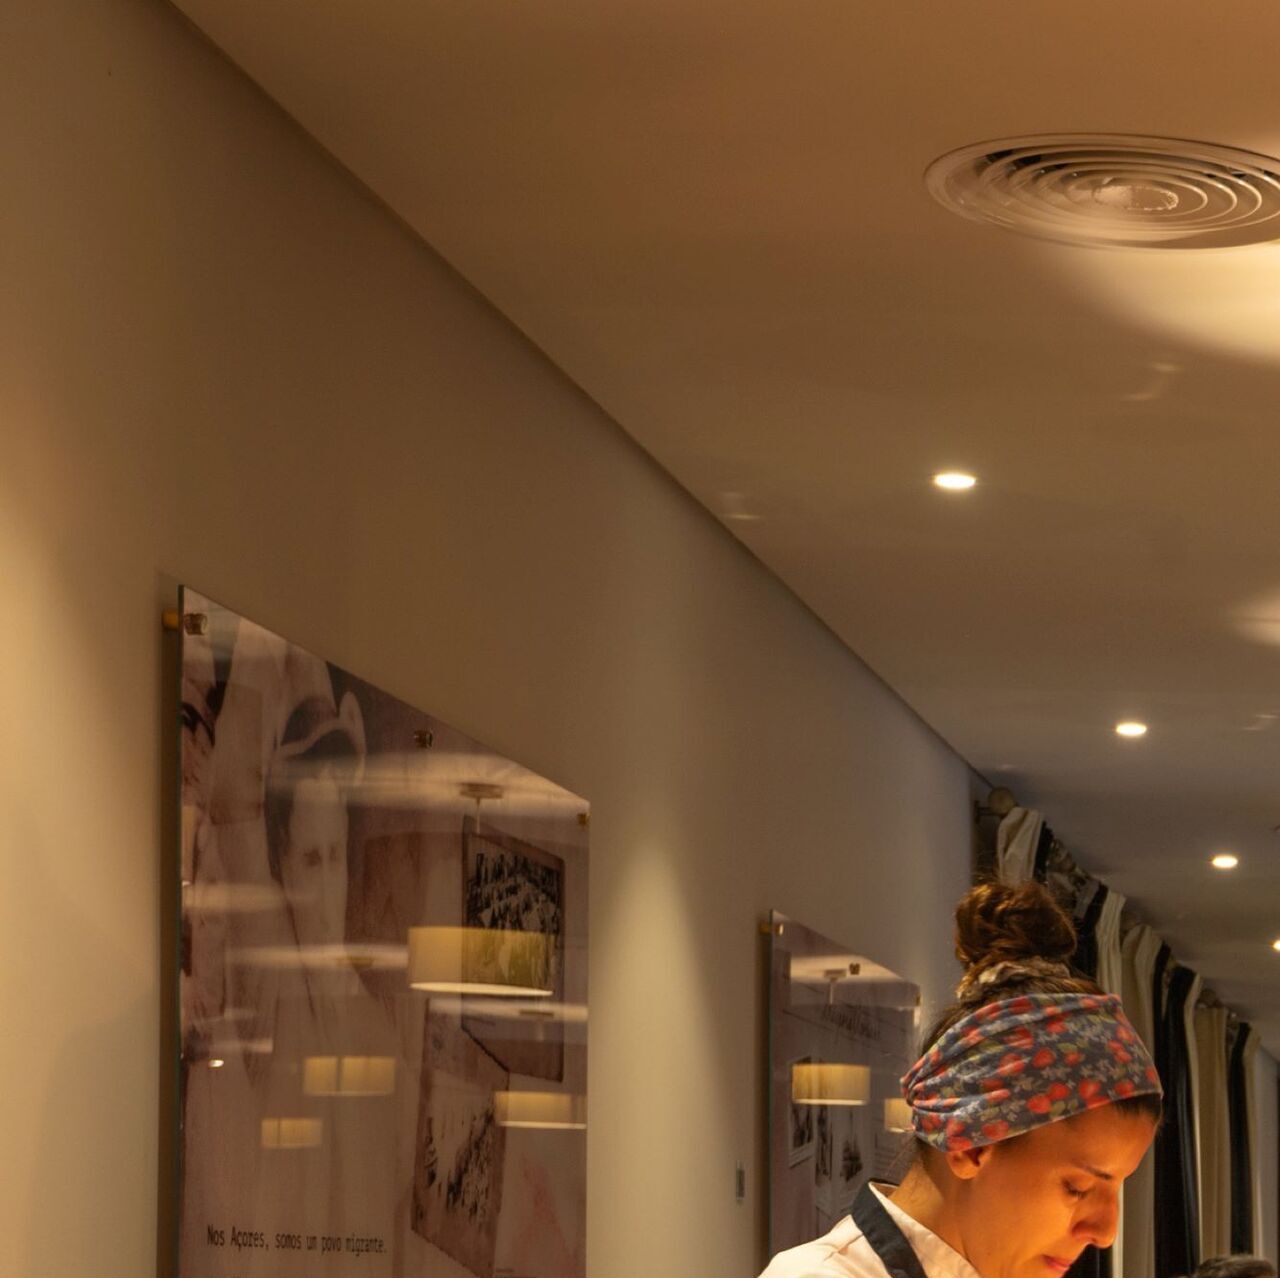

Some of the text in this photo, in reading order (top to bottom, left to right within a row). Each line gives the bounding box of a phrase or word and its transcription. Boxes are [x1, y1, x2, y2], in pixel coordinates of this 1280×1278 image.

[207, 1223, 388, 1257] Nos Açores, somos um povo migrante.
